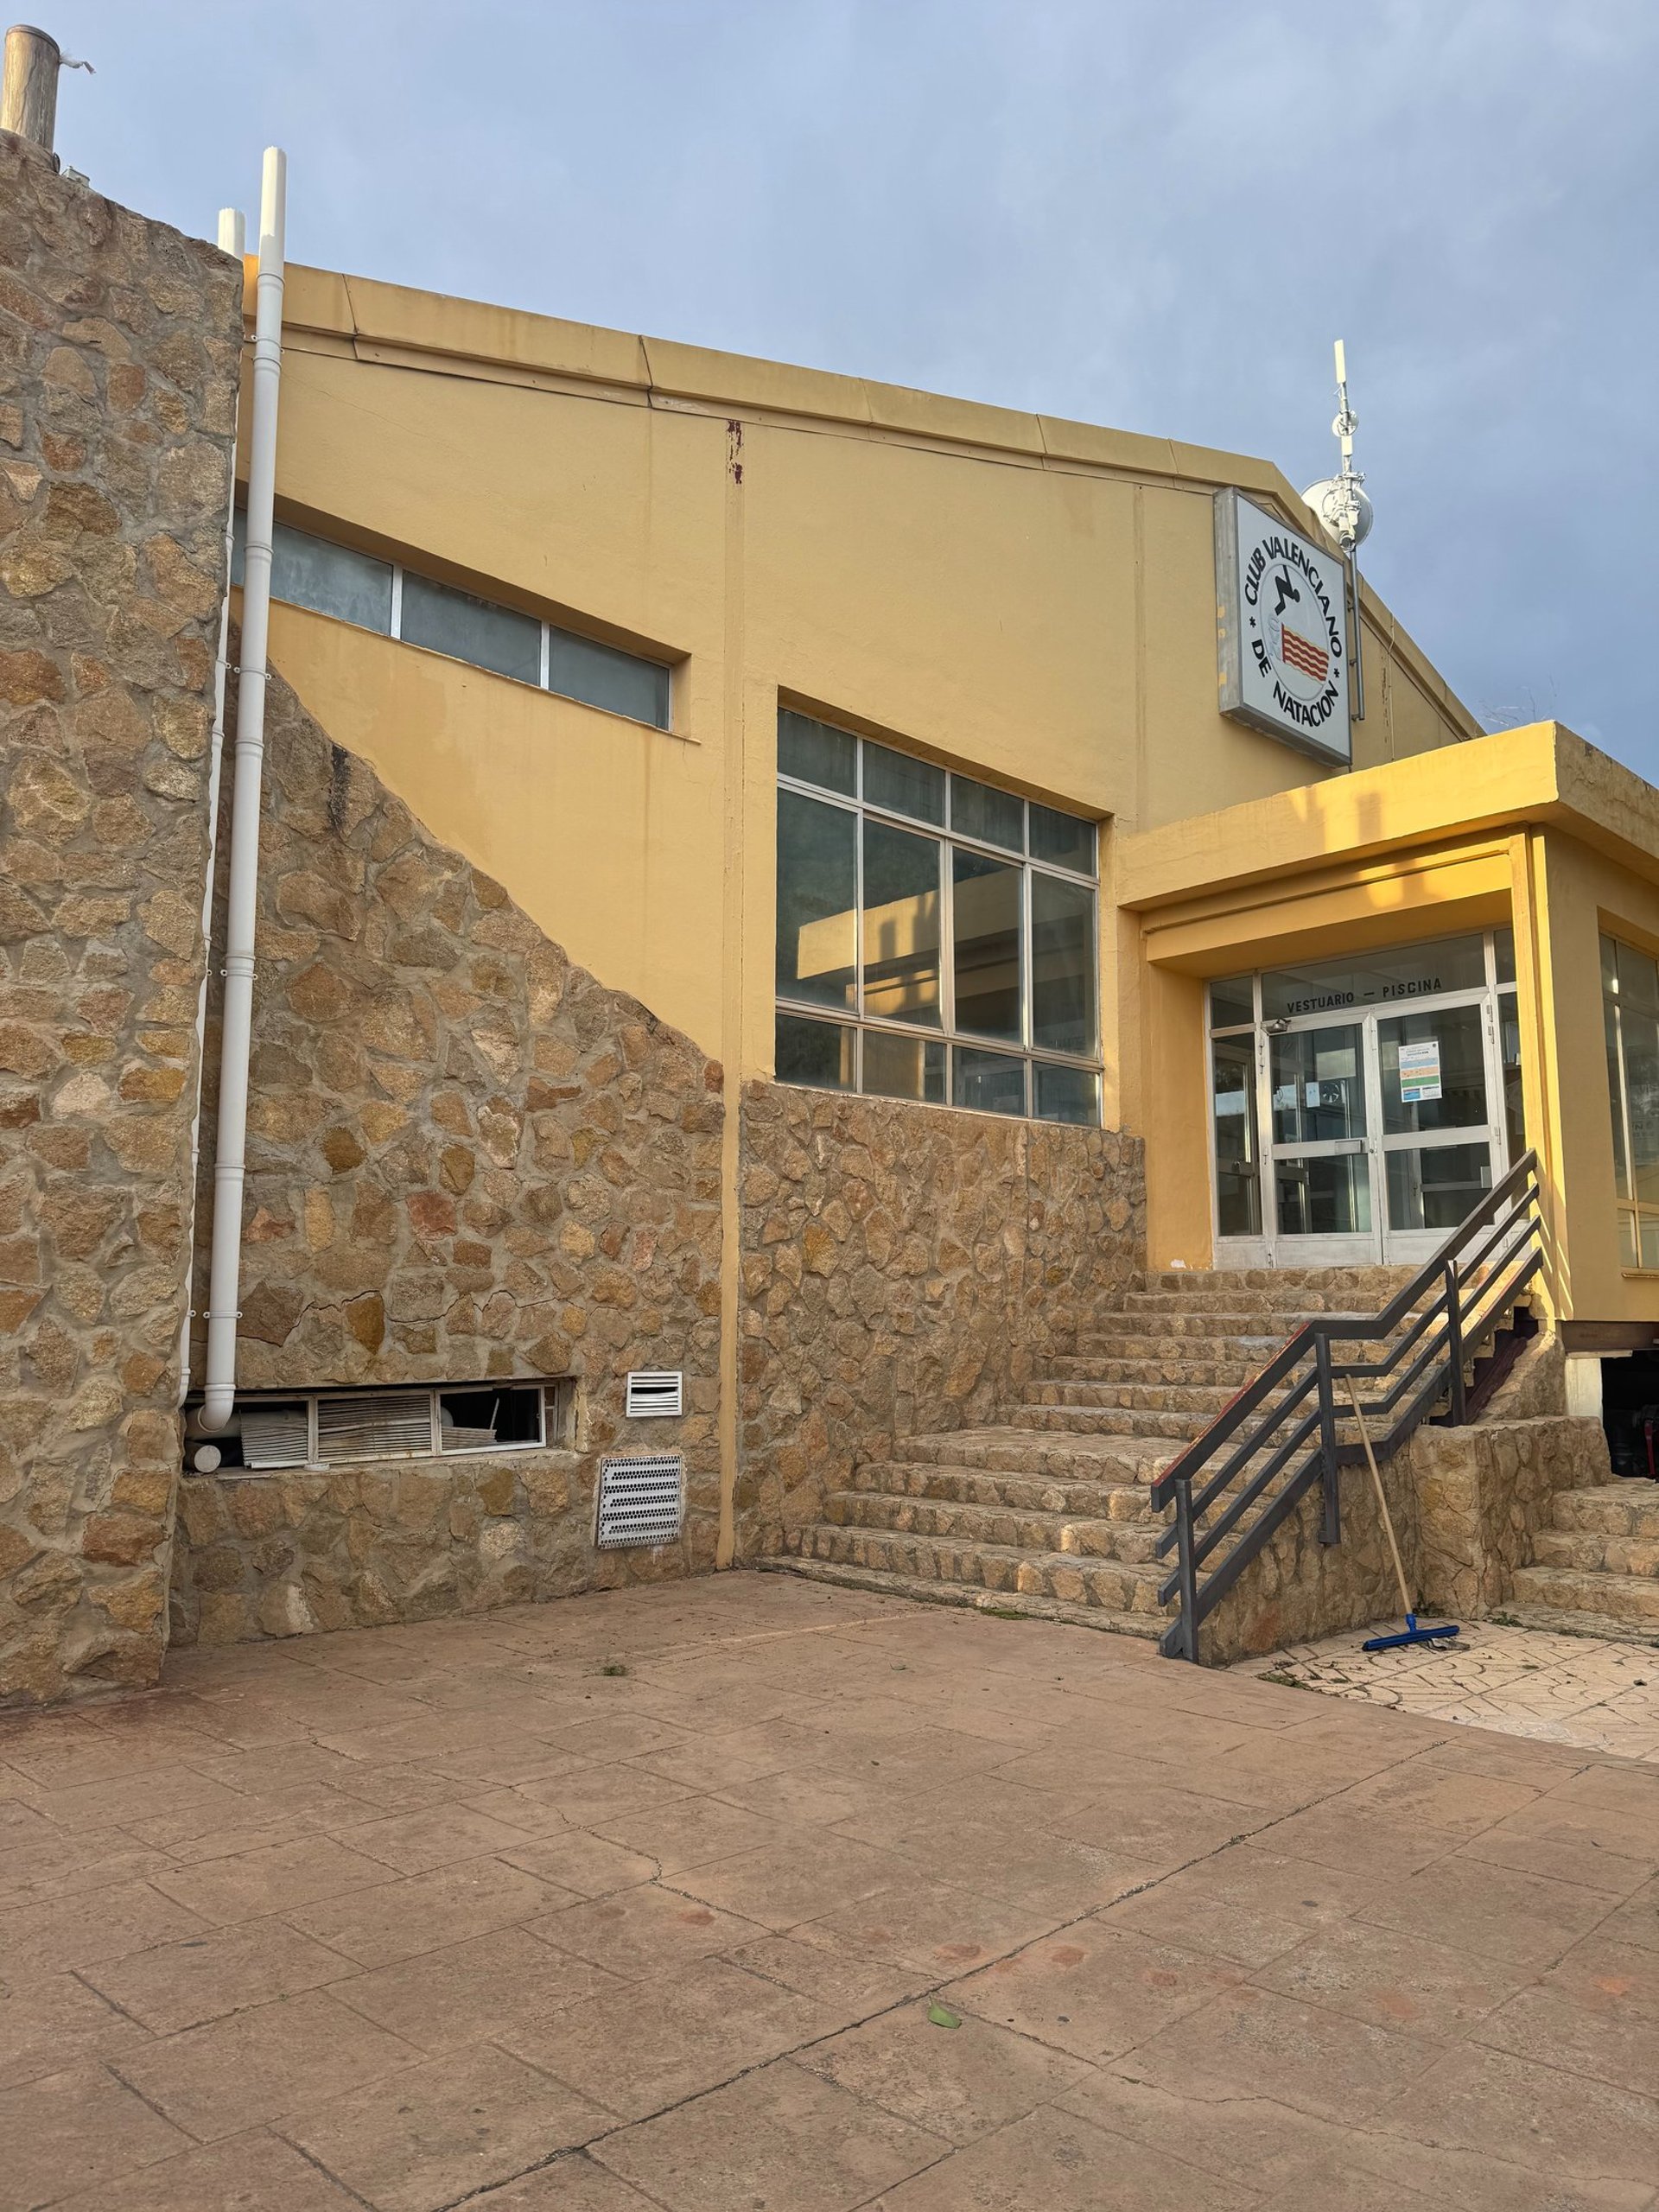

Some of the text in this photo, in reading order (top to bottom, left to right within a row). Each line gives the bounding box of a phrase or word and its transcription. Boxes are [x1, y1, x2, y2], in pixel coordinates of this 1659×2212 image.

[1244, 536, 1342, 658] CLUB VALENCIANO
[1251, 638, 1339, 728] DE NATACION
[1287, 991, 1354, 1014] VESTUARIO
[1382, 977, 1442, 998] PISCINA
